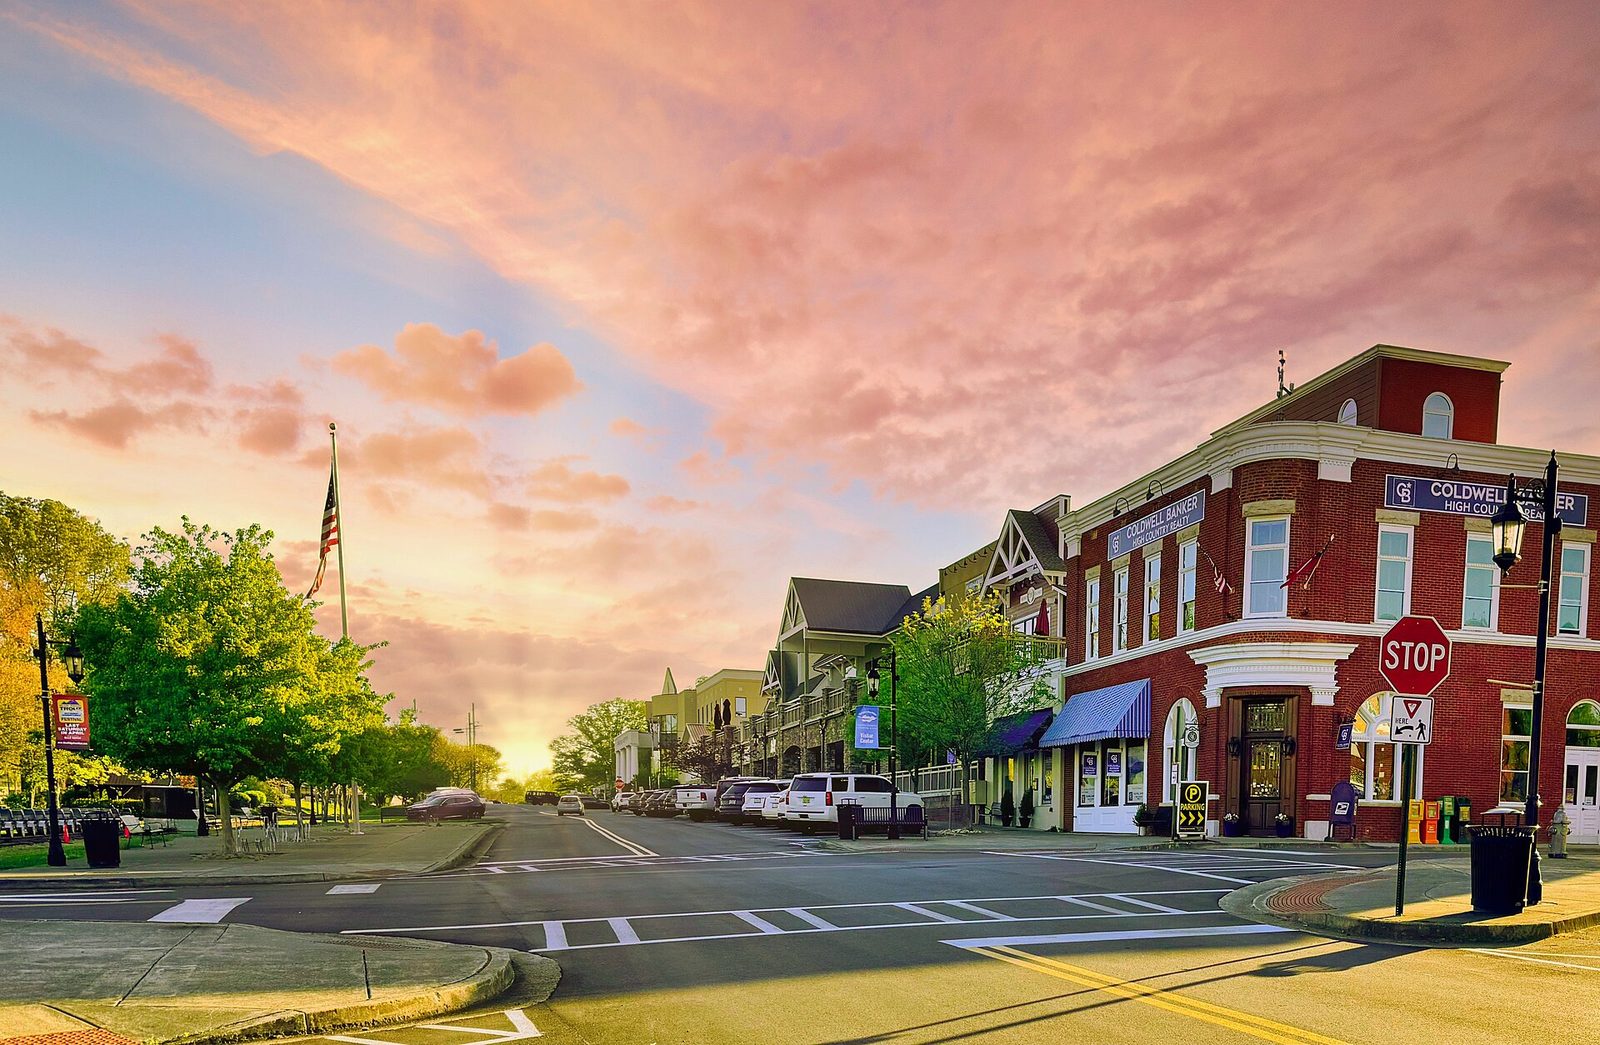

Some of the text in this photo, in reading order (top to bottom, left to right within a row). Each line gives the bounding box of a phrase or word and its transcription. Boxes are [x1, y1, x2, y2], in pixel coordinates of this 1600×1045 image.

[1430, 481, 1508, 504] COLDWELL
[1444, 500, 1471, 513] HIGH
[1126, 495, 1198, 539] COLDWELL BANKER
[1132, 514, 1190, 548] HIGH COUNTRY REALTY
[1384, 640, 1446, 672] STOP
[1395, 717, 1409, 725] HERE
[1189, 787, 1198, 800] P
[1180, 803, 1205, 811] PARKING
